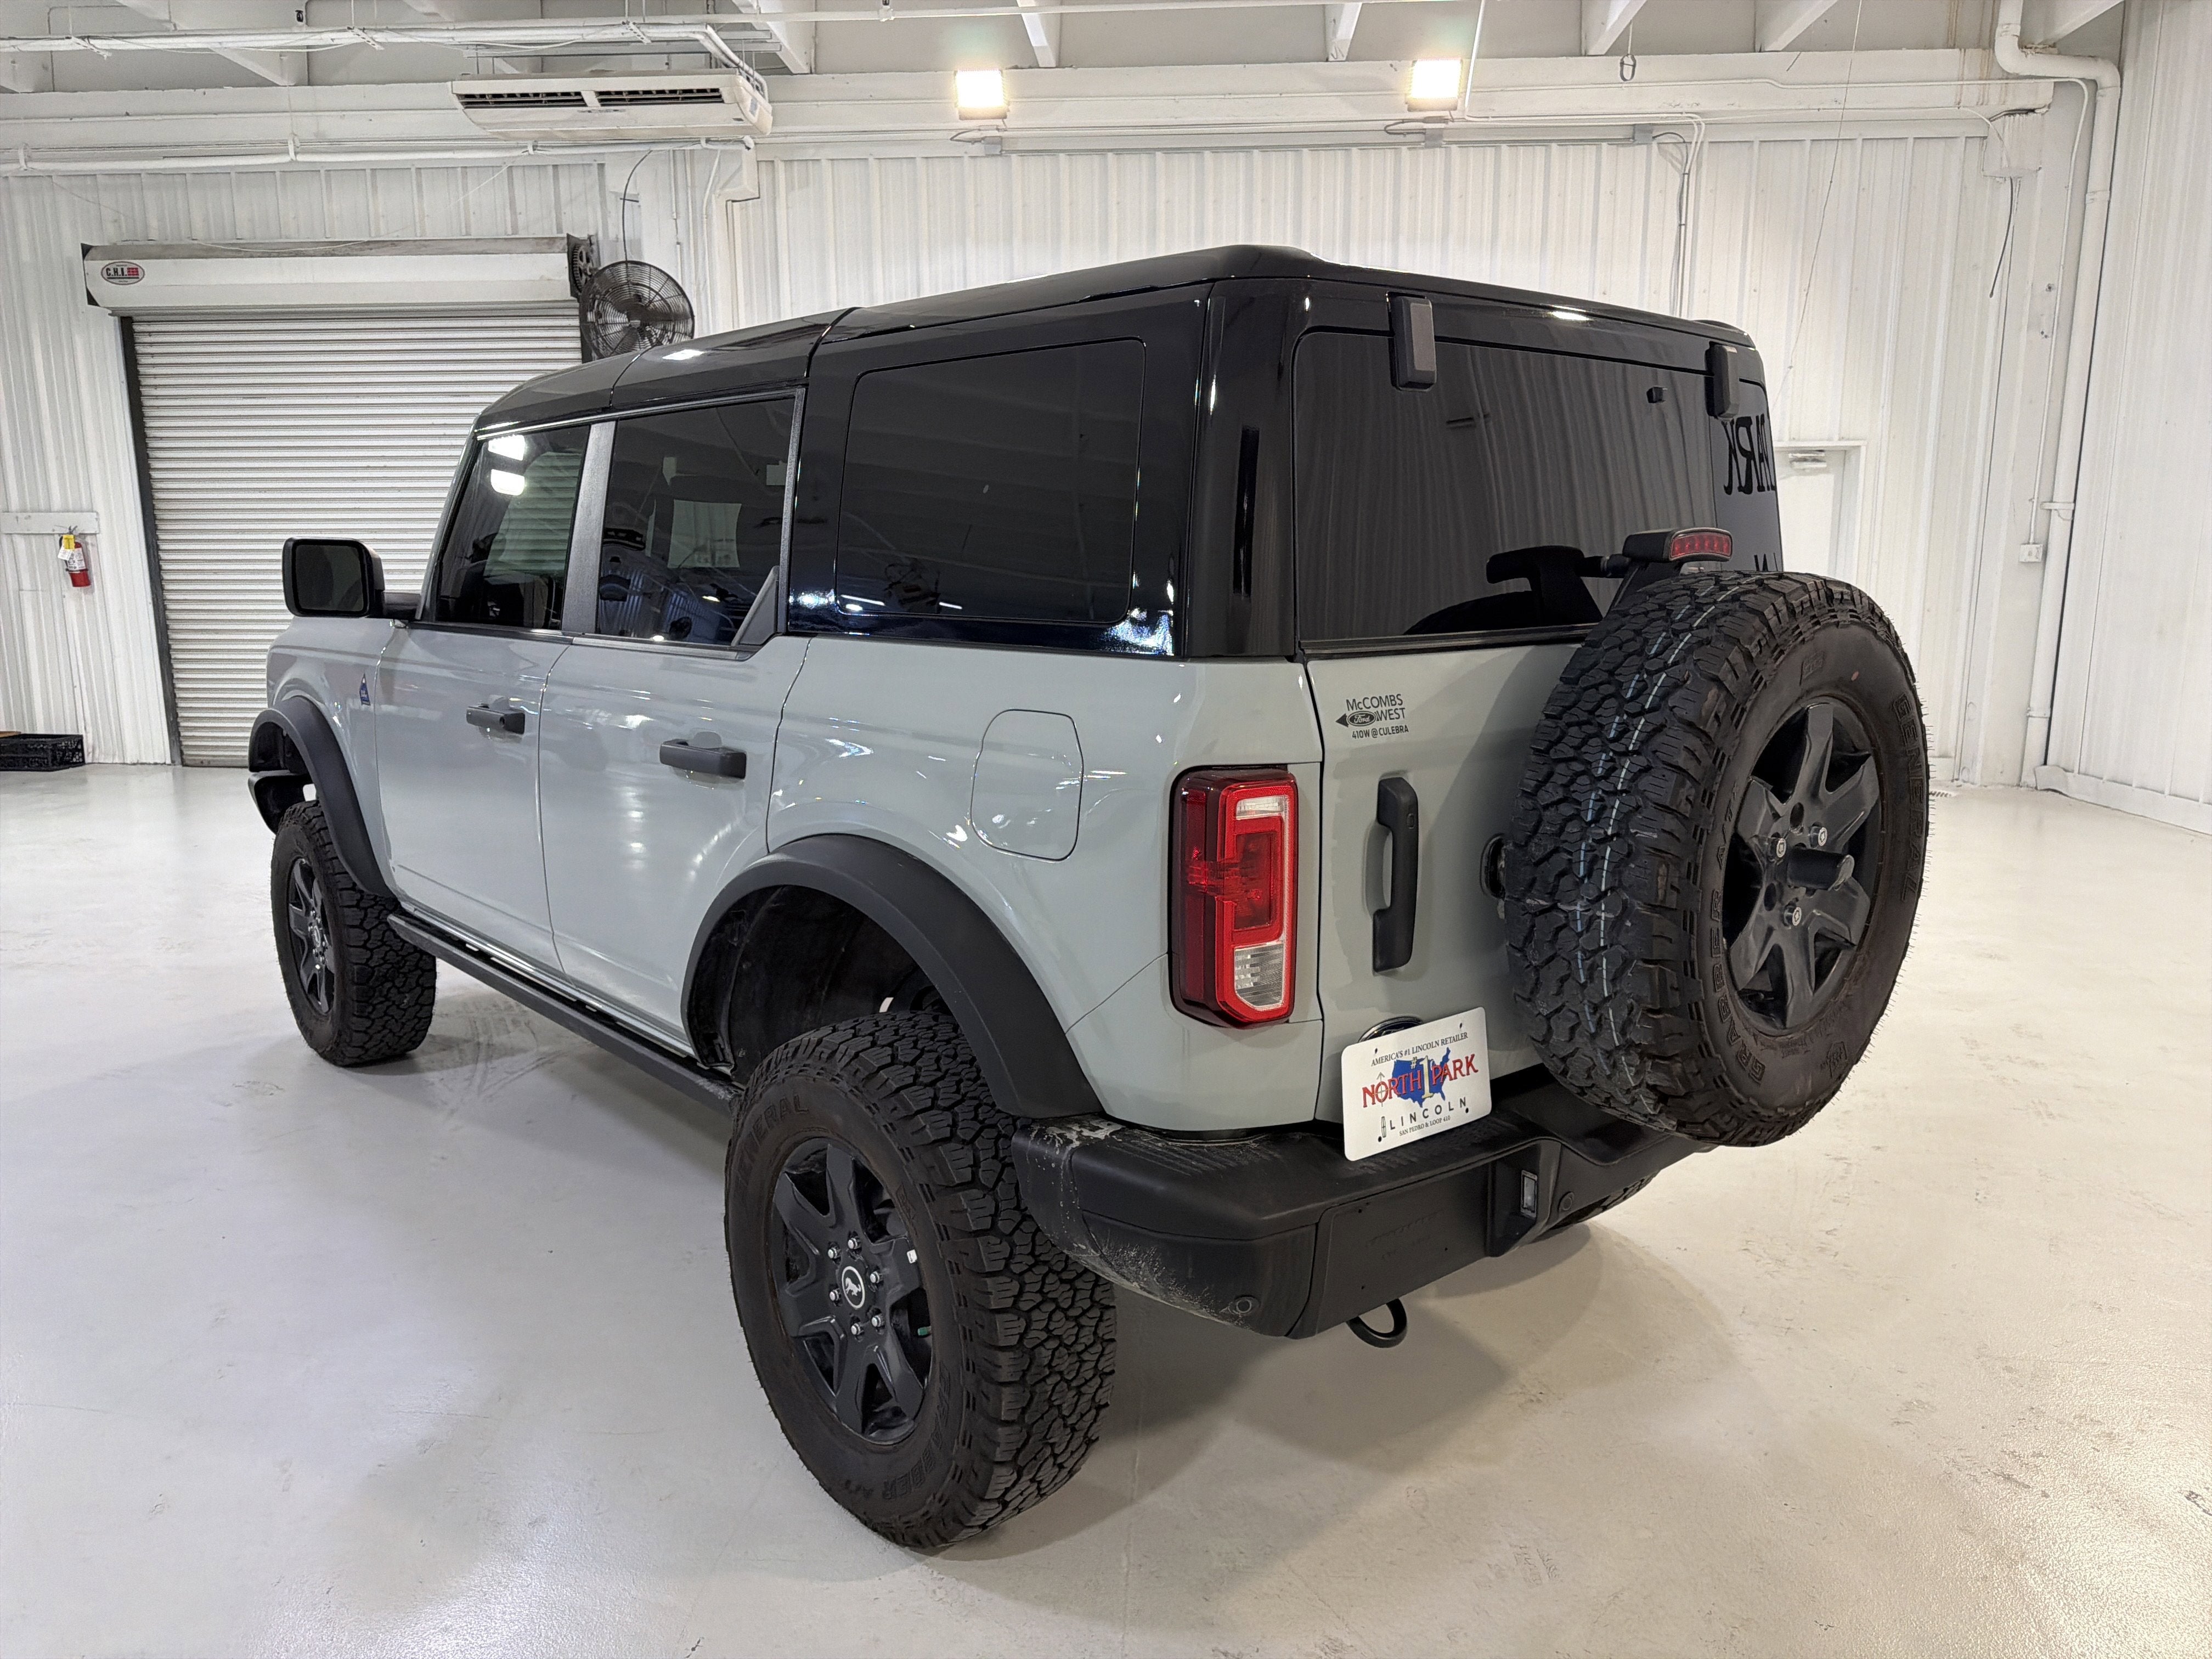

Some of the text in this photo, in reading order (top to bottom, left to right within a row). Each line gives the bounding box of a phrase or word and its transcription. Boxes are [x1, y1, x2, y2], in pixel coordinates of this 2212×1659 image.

[1346, 693, 1403, 712] McCOMBS
[1353, 714, 1370, 724] Ford
[1375, 707, 1406, 721] WEST
[1379, 725, 1409, 736] CULEBRA
[1371, 1049, 1403, 1067] AMERICA'S
[1411, 1040, 1440, 1054] LINCOLN
[1440, 1031, 1469, 1047] RETAILER
[1362, 1053, 1479, 1108] NORTH PARK
[1389, 1097, 1466, 1131] LINCOLN
[1399, 1128, 1409, 1137] SAN
[1409, 1123, 1425, 1133] PEDRO
[1430, 1118, 1442, 1126] LOOP
